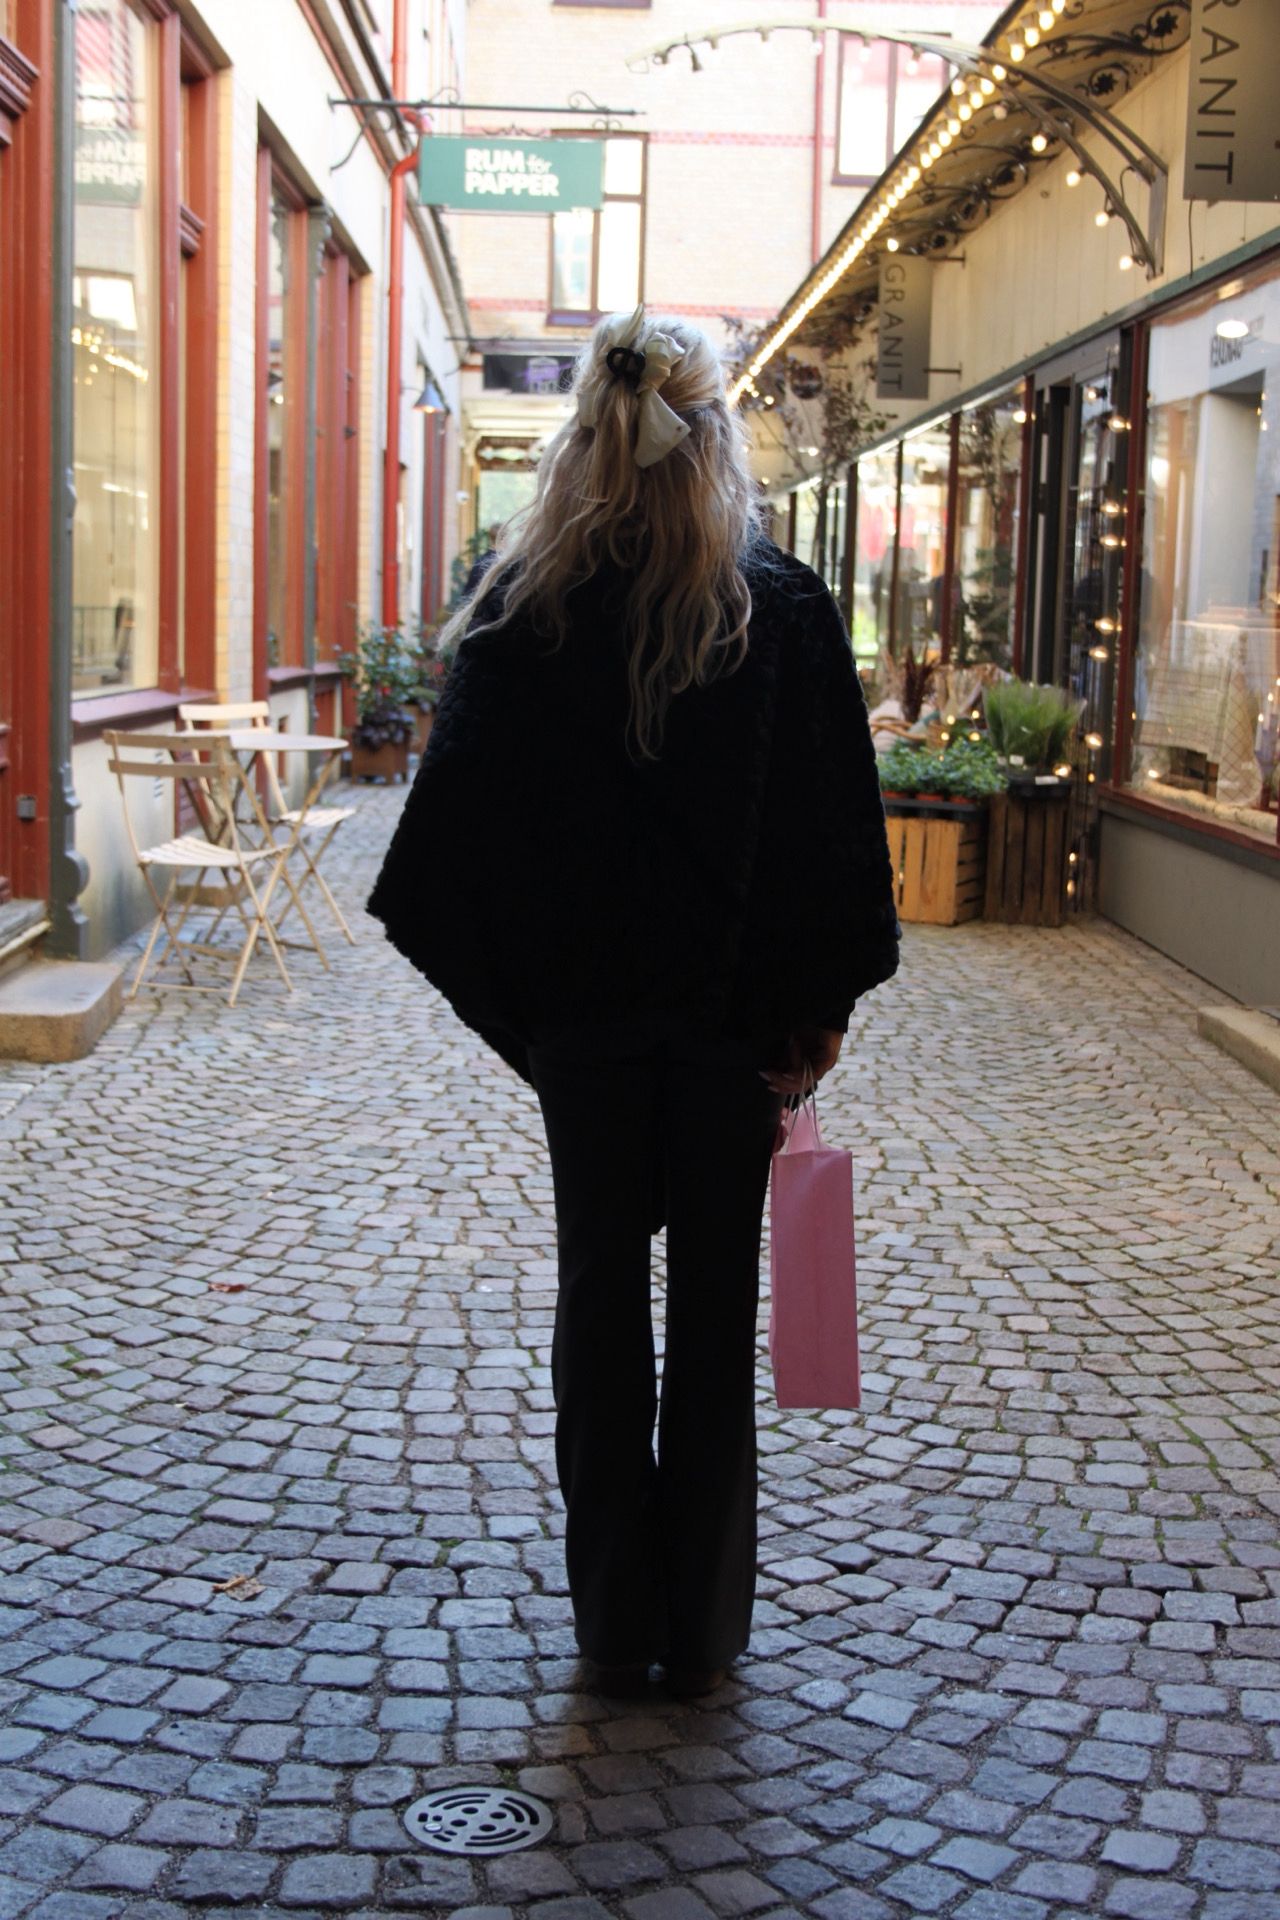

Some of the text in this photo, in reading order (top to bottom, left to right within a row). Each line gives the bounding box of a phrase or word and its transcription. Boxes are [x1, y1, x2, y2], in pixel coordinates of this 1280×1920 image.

[465, 148, 552, 174] RUM for
[464, 171, 560, 197] PAPPER
[881, 263, 906, 392] GRANIT
